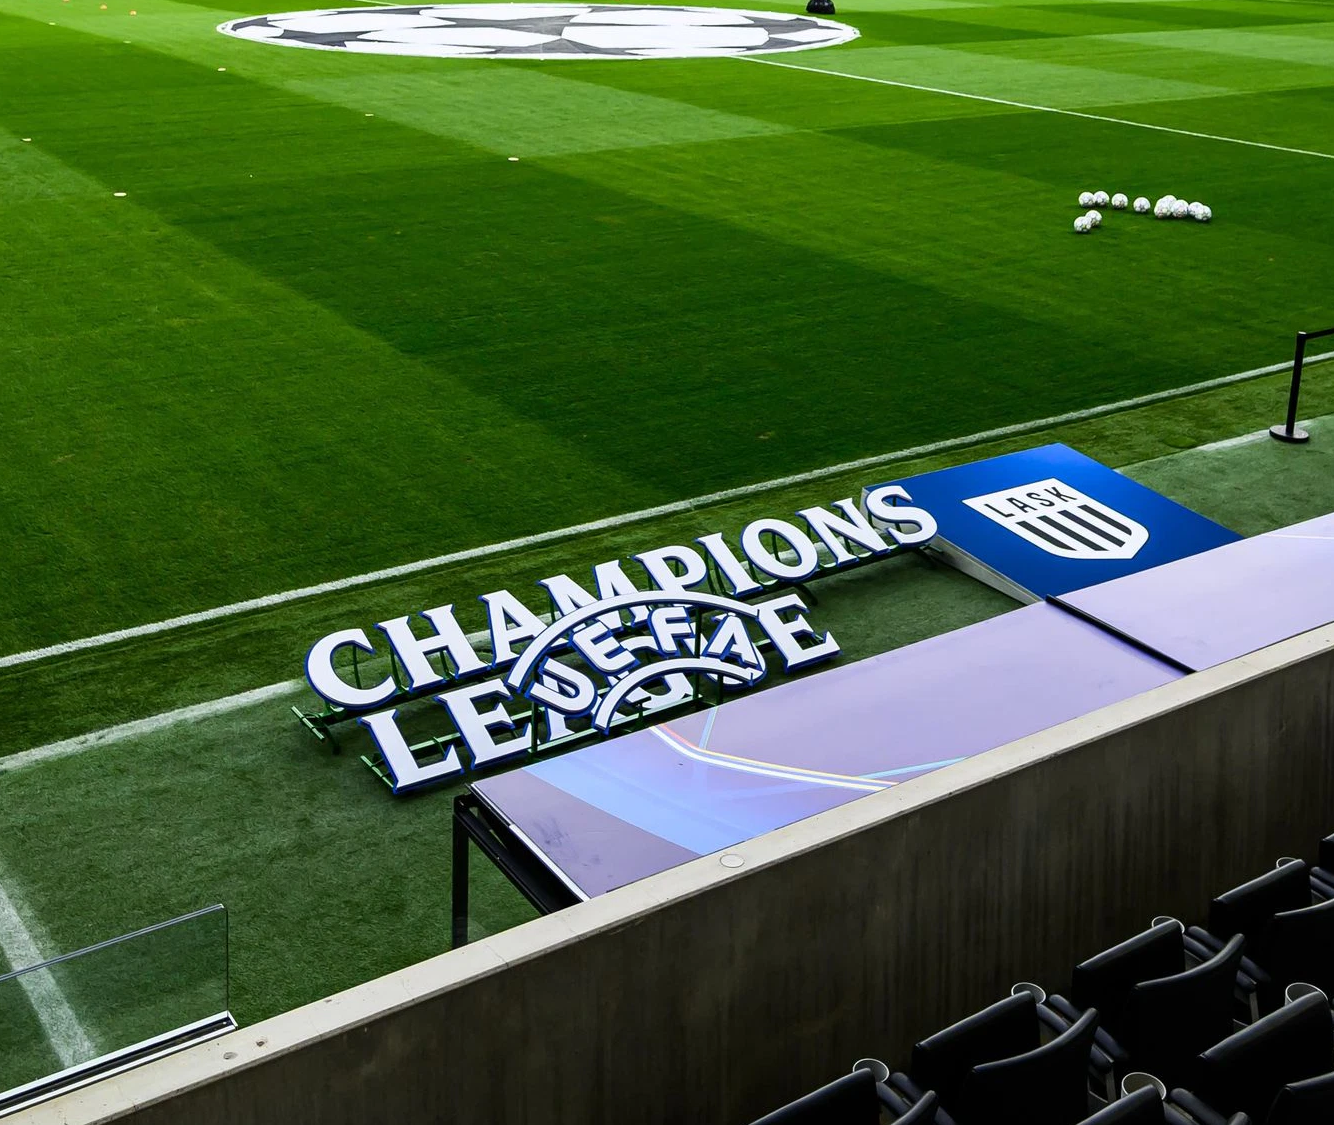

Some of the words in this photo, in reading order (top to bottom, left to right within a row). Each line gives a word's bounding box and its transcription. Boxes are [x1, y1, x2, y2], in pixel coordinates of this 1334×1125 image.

[984, 486, 1078, 519] LASK
[306, 484, 939, 711] CHAMPIONS
[528, 607, 757, 717] UEFA
